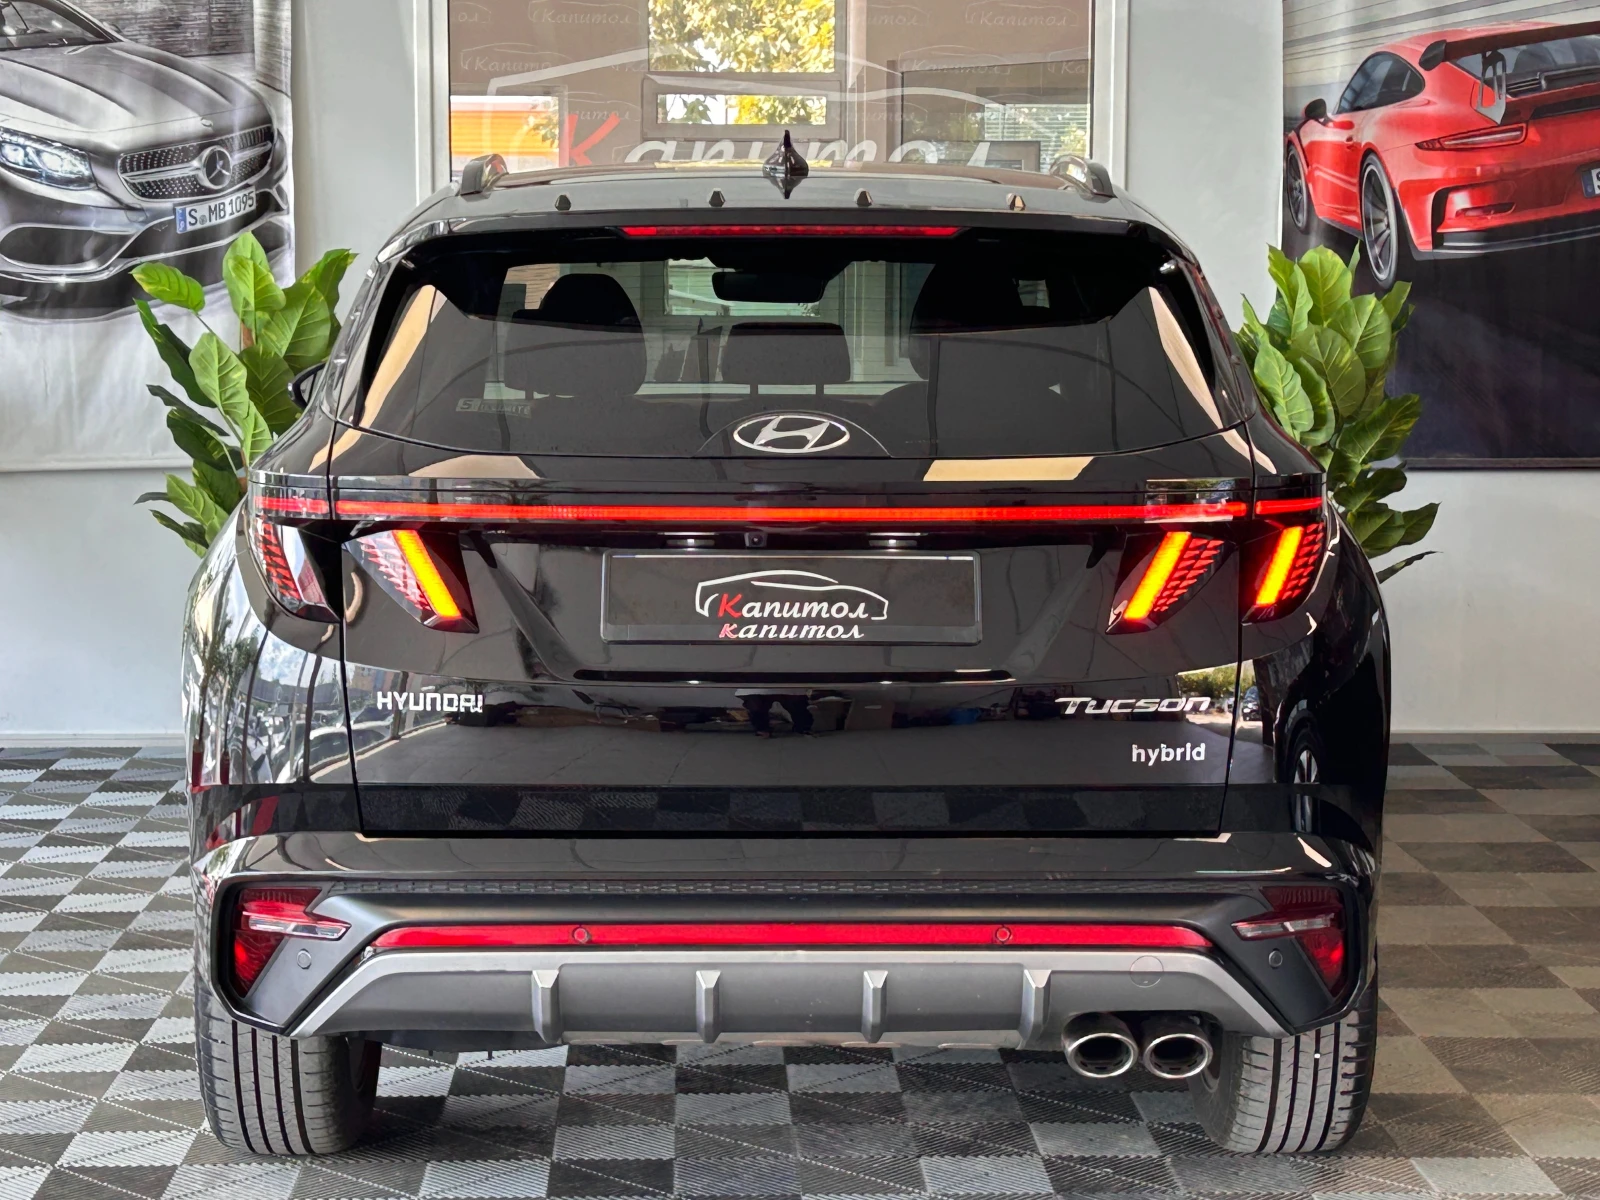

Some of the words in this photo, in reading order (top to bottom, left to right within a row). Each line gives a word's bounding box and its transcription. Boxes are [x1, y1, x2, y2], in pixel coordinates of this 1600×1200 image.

[474, 57, 553, 71] Капито
[188, 208, 198, 226] S
[208, 202, 227, 223] MB
[228, 190, 255, 216] 1095
[717, 593, 869, 619] Капитол
[377, 691, 483, 713] HYUNDAI
[1132, 742, 1206, 766] hybrid
